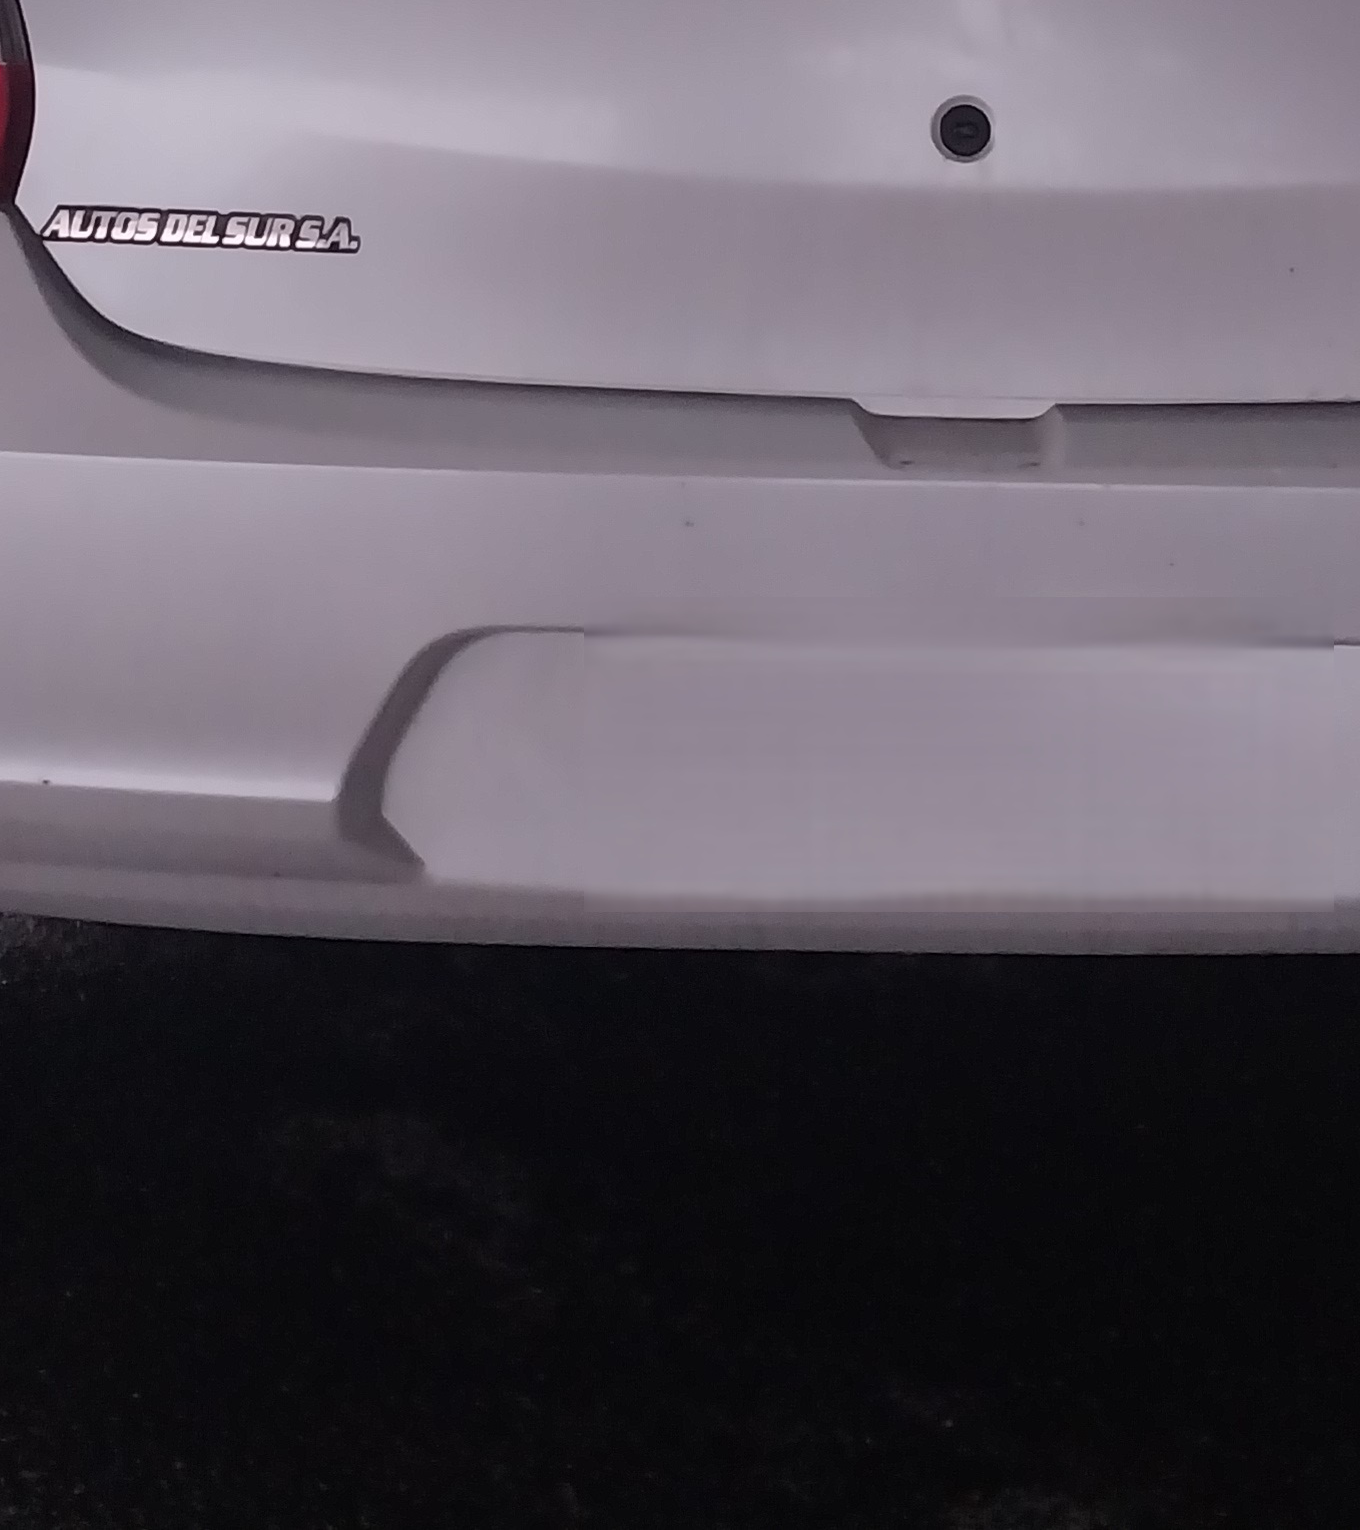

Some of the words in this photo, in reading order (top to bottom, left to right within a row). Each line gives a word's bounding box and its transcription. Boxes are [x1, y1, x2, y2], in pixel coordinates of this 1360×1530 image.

[42, 208, 161, 242] AUTOS
[159, 213, 220, 245] DEL
[222, 216, 293, 248] SUR
